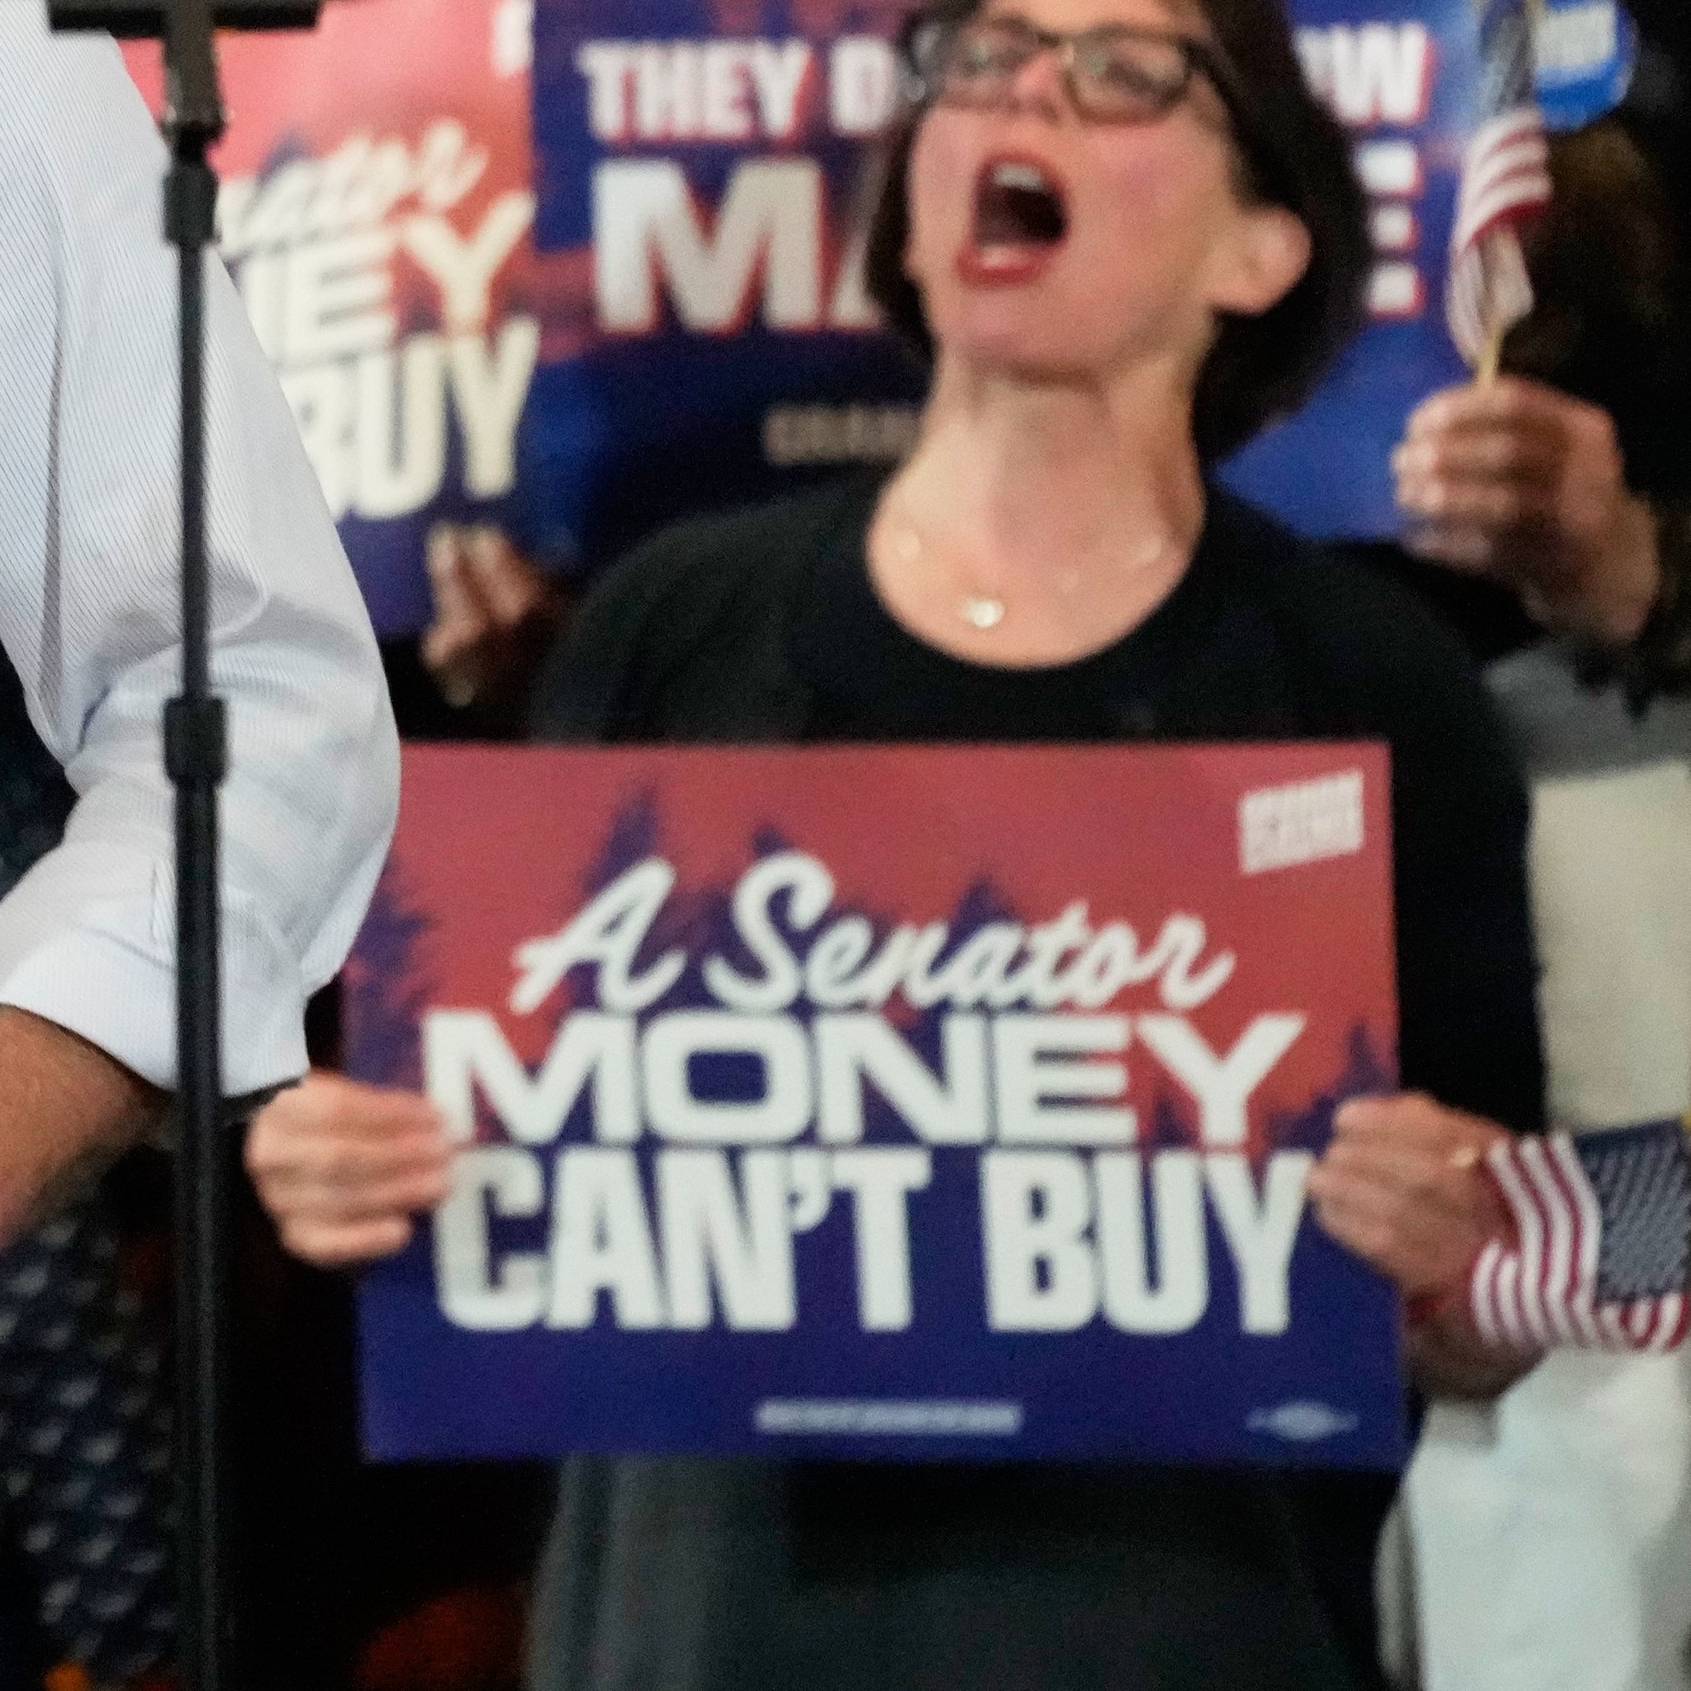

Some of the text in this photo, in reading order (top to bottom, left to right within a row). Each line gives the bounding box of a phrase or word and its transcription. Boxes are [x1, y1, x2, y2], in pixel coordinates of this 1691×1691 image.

[577, 38, 811, 138] THEY
[513, 851, 1234, 1015] A Senator
[422, 1009, 1307, 1147] MONEY
[436, 1147, 1314, 1334] CAN'T BUY
